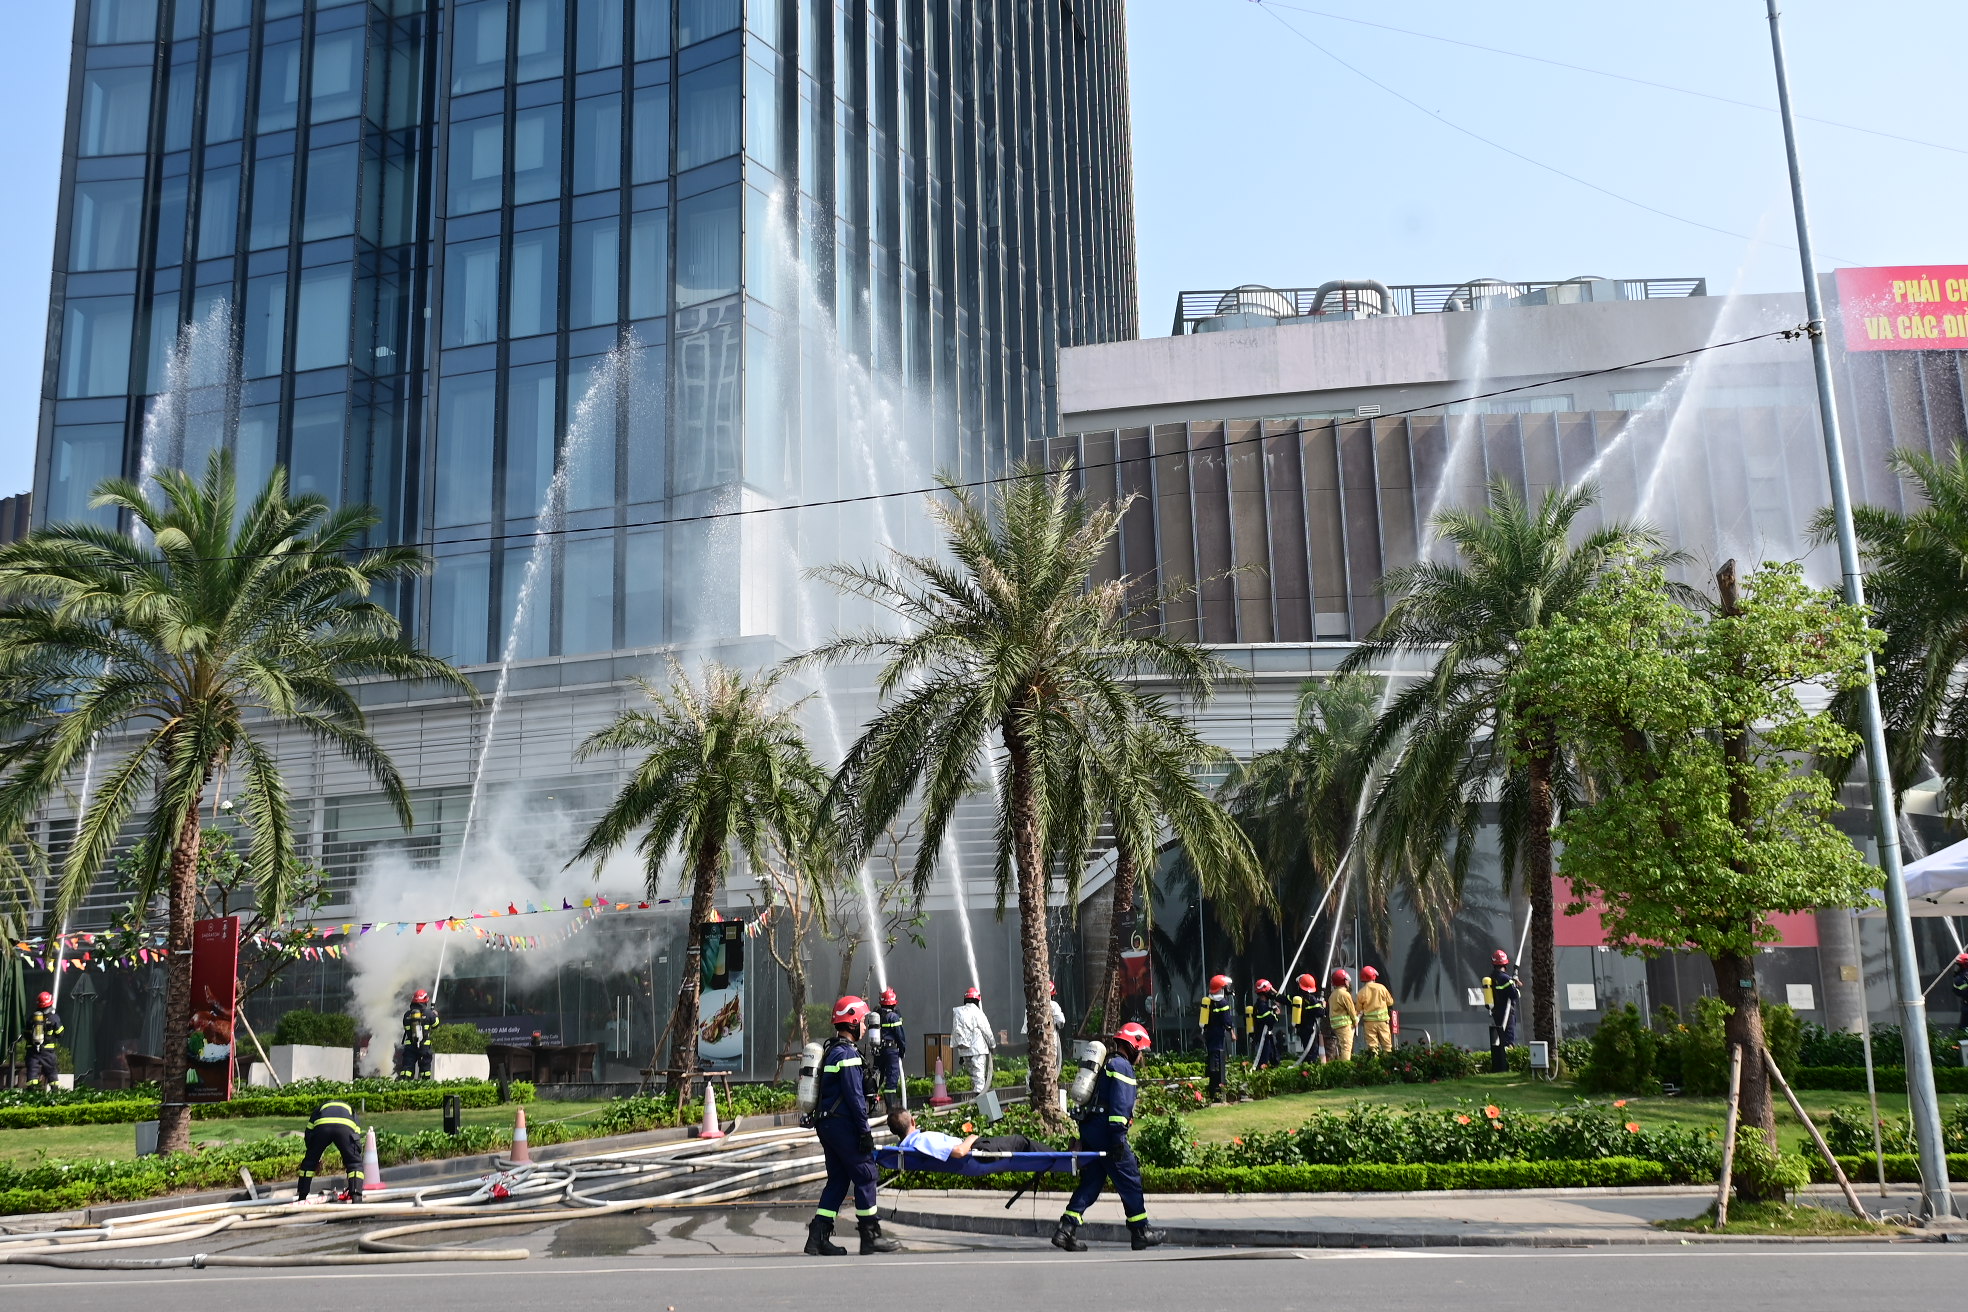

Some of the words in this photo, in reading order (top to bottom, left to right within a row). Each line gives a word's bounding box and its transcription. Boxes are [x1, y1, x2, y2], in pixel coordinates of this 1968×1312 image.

[1892, 274, 1941, 303] PHẢI
[1864, 313, 1895, 340] VÀ
[1897, 312, 1938, 339] CÁC
[508, 1026, 520, 1034] daily
